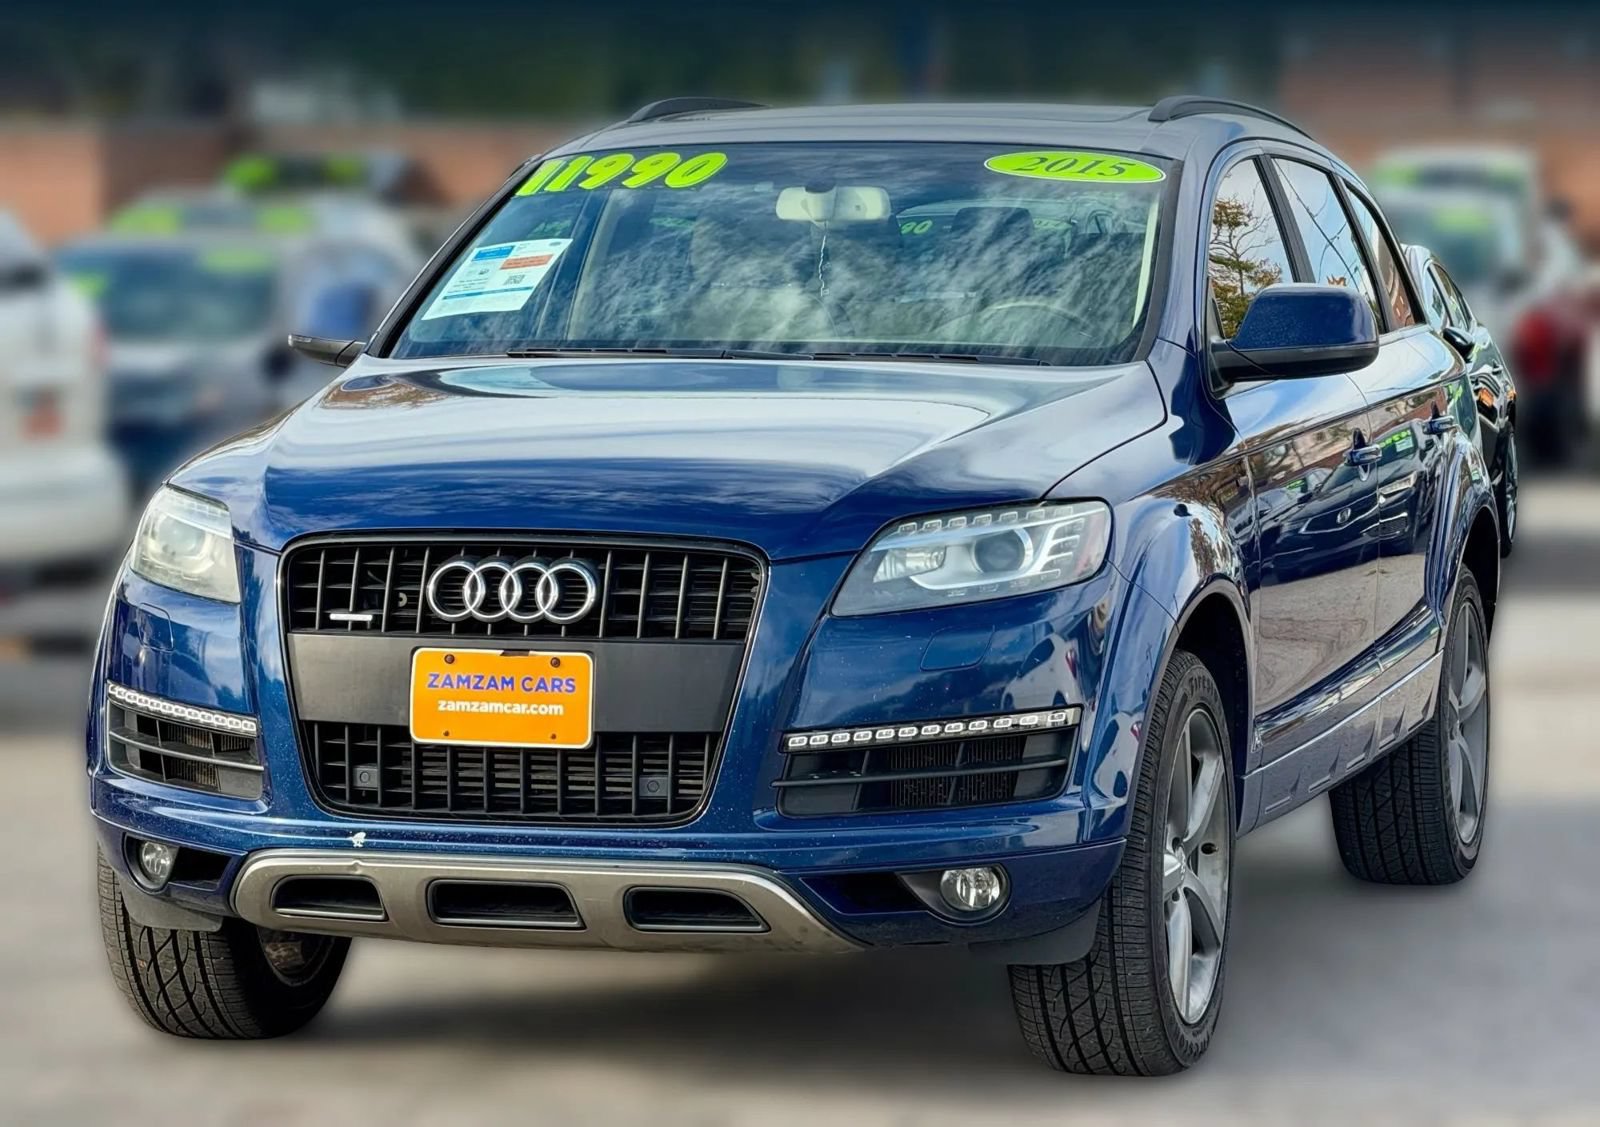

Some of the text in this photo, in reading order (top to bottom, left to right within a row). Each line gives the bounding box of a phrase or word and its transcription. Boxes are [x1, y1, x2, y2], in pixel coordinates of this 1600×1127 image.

[515, 152, 728, 196] 11990
[1011, 156, 1137, 177] 2015
[427, 673, 577, 693] ZAMZAM CARS
[438, 699, 565, 716] zamzamcar.com
